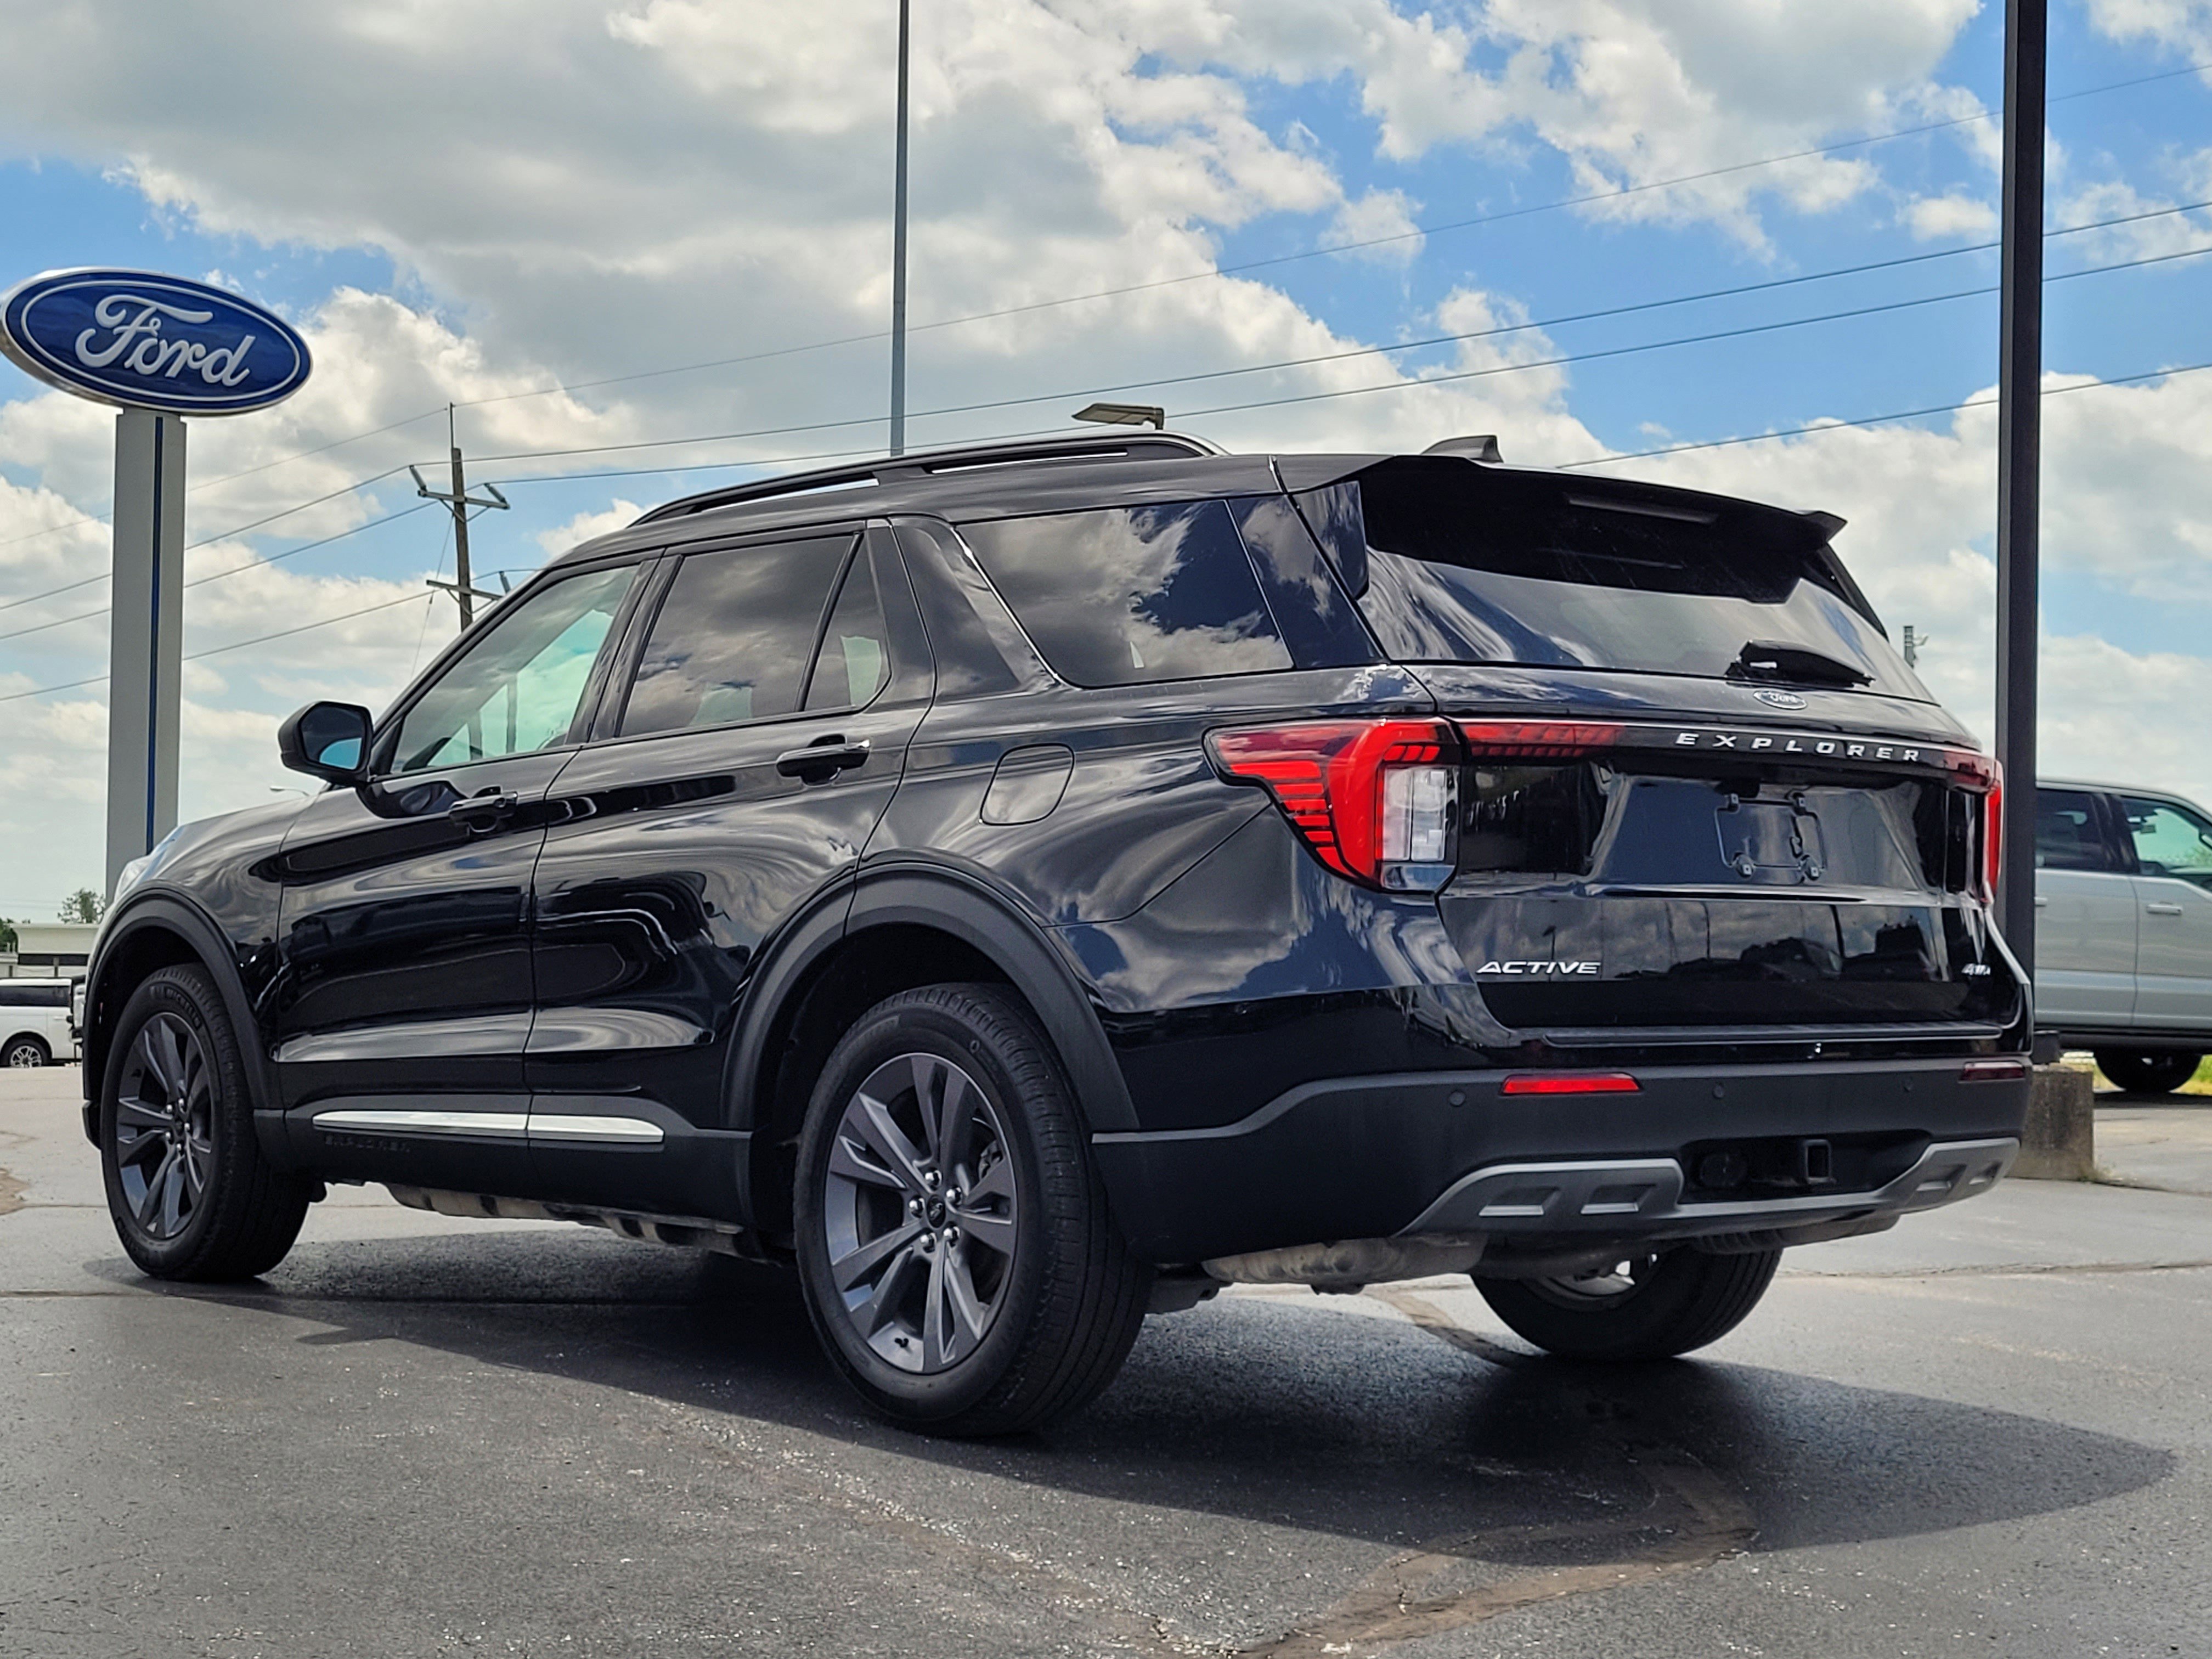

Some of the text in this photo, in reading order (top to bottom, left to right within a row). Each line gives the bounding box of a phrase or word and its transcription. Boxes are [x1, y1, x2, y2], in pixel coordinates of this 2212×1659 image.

[75, 294, 256, 386] Ford
[1675, 732, 1920, 762] EXPLORER
[1476, 961, 1601, 974] ACTIVE
